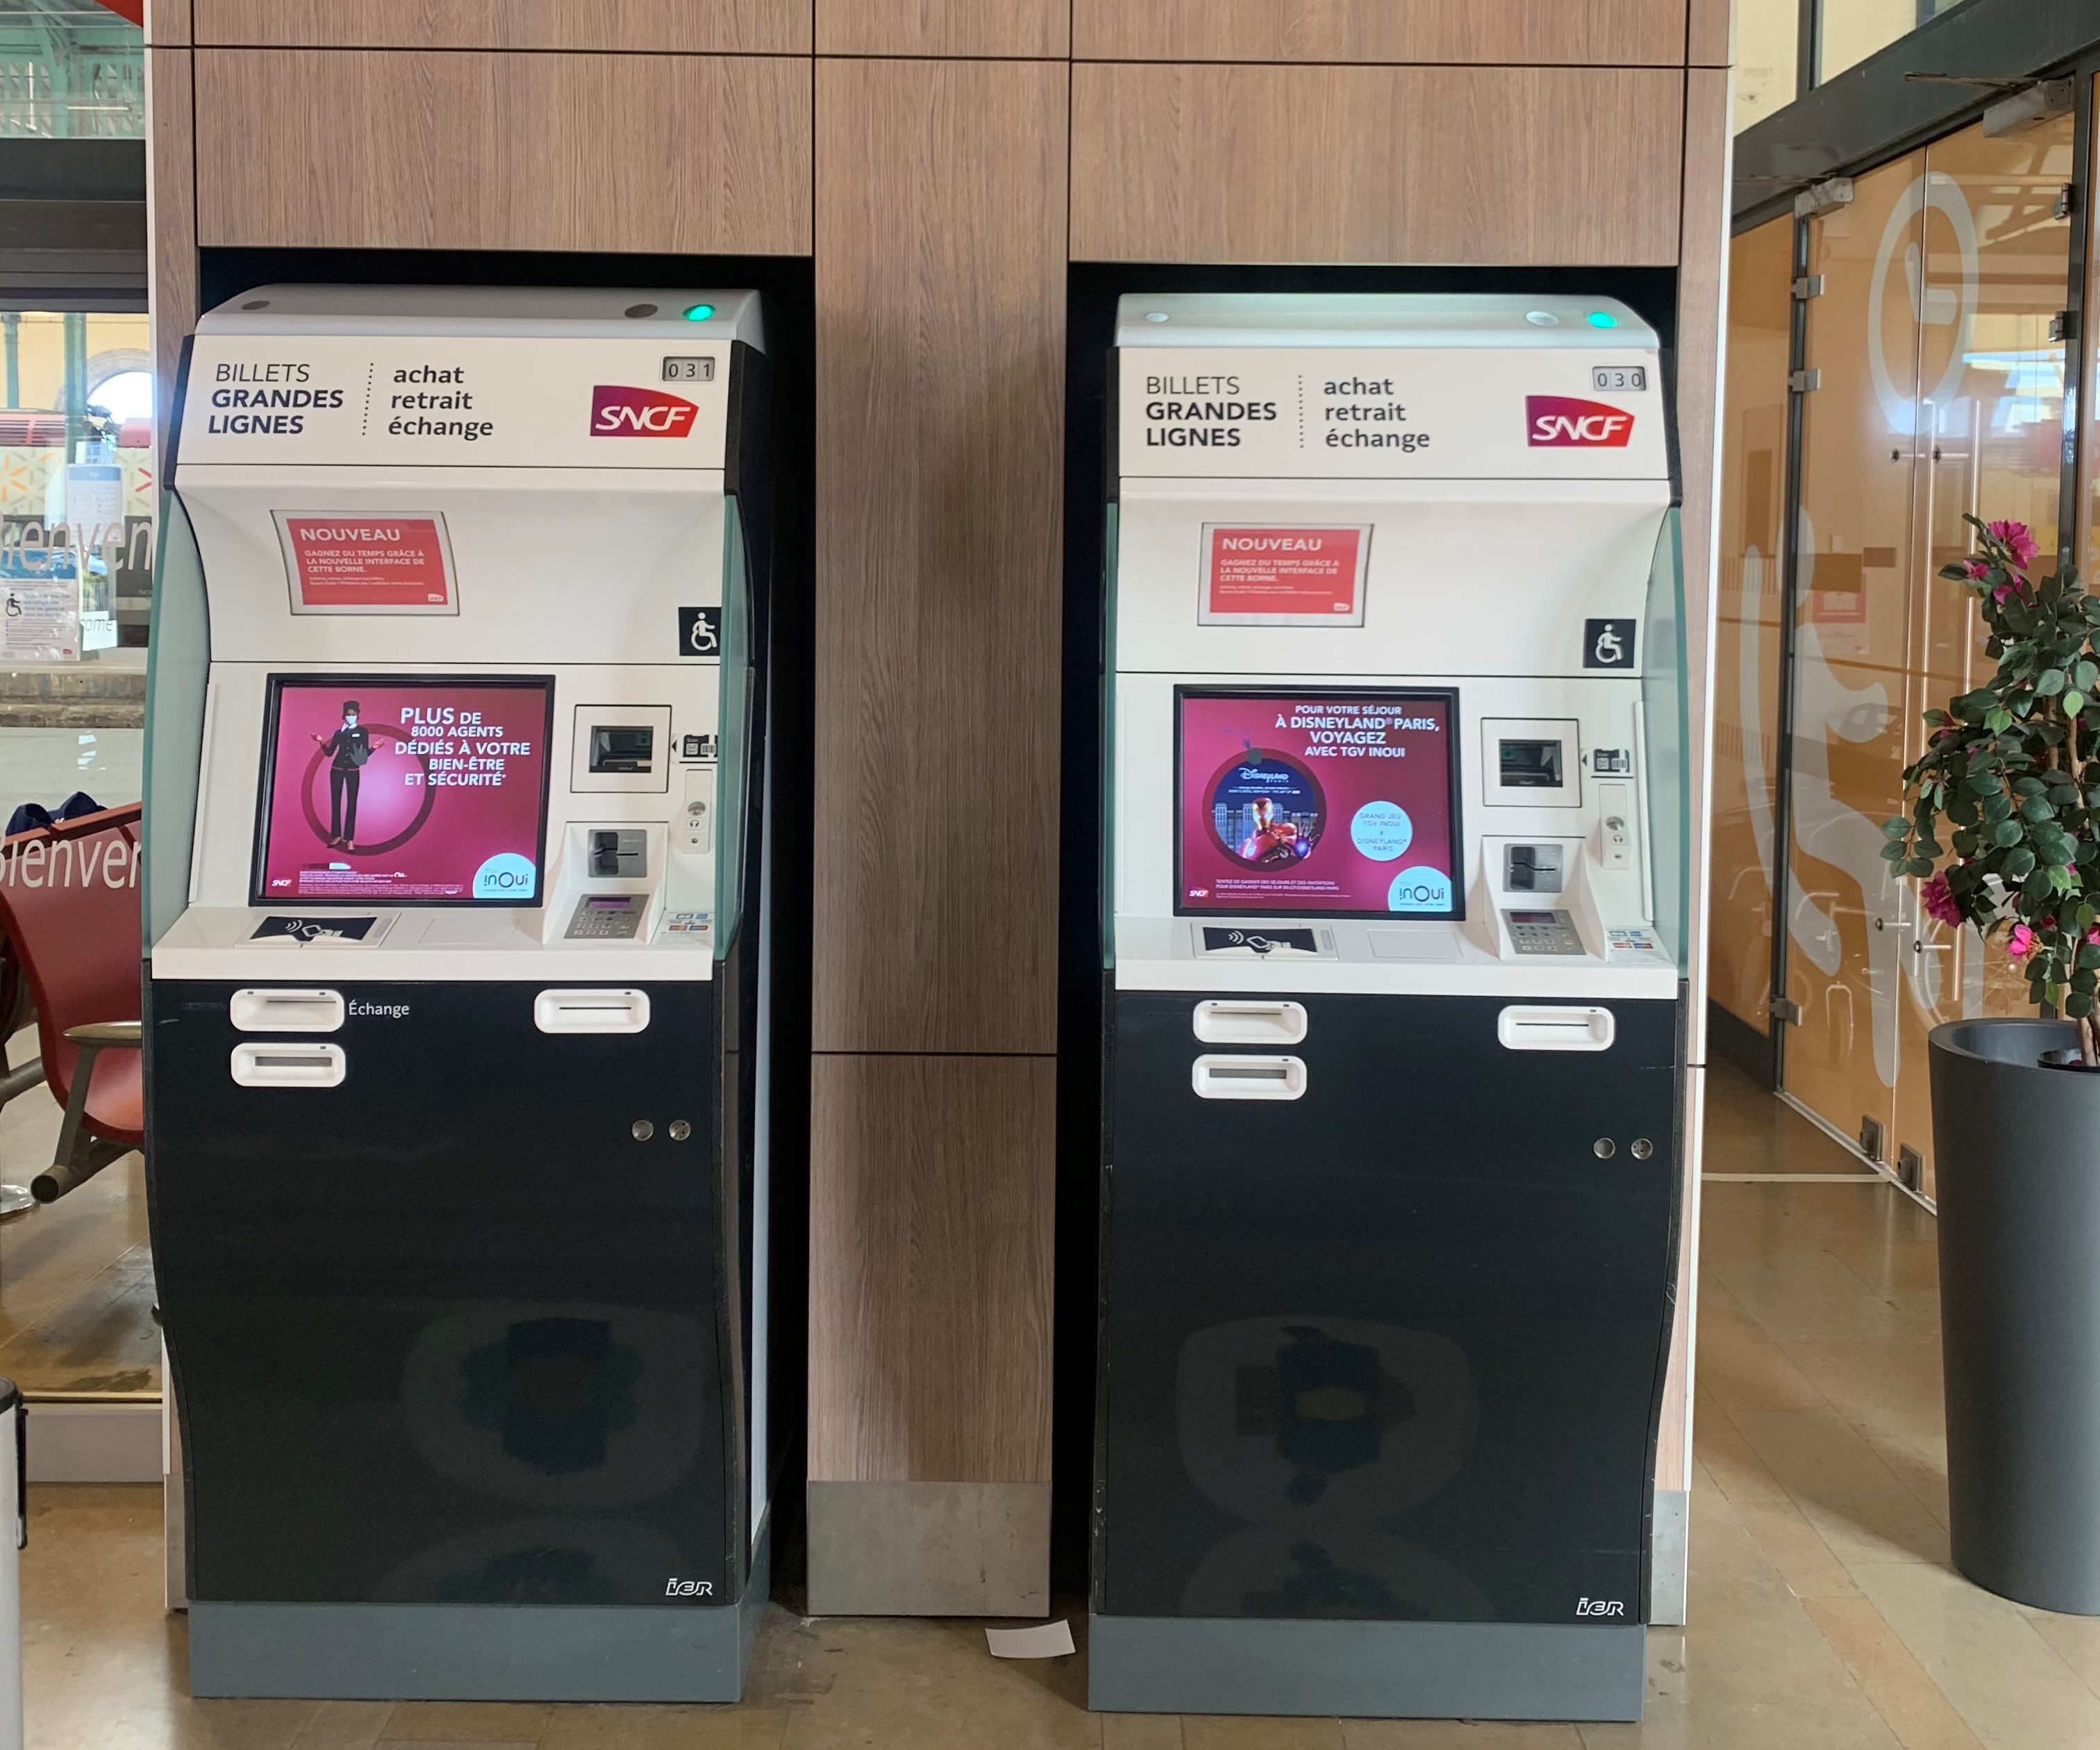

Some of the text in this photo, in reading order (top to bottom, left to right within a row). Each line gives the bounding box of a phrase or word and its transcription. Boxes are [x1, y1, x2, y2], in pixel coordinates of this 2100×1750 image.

[215, 364, 310, 382] BILLETS
[393, 365, 465, 384] achat
[669, 364, 710, 377] 031
[1146, 376, 1240, 395] BILLETS
[1324, 377, 1394, 395] achat
[1597, 373, 1642, 387] 030
[211, 389, 344, 408] GRANDES
[391, 391, 474, 409] retrait
[595, 406, 692, 431] SNCF
[1146, 401, 1277, 421] GRANDES
[1324, 403, 1406, 422] retrait
[208, 415, 304, 434] LIGNES
[388, 415, 494, 441] échange
[1531, 415, 1628, 441] SNCF
[1147, 428, 1242, 447] LIGNES
[1325, 428, 1431, 453] échange
[299, 528, 401, 541] NOUVEAU
[1222, 538, 1322, 551] NOUVEAU
[401, 707, 482, 724] PLUS DE
[1295, 704, 1402, 715] POUR VOTRE SÉJOUR
[411, 726, 503, 738] 8000 AGENTS
[1275, 714, 1287, 728] À
[1394, 718, 1440, 732] PARIS,
[1310, 731, 1386, 744] VOYAGEZ
[394, 739, 531, 755] DÉDIÉS À VOTRE
[1304, 747, 1405, 758] AVEC TGV INOUI
[429, 756, 505, 770] BIEN-ÊTRE
[405, 773, 424, 785] ET
[349, 999, 410, 1018] Échange
